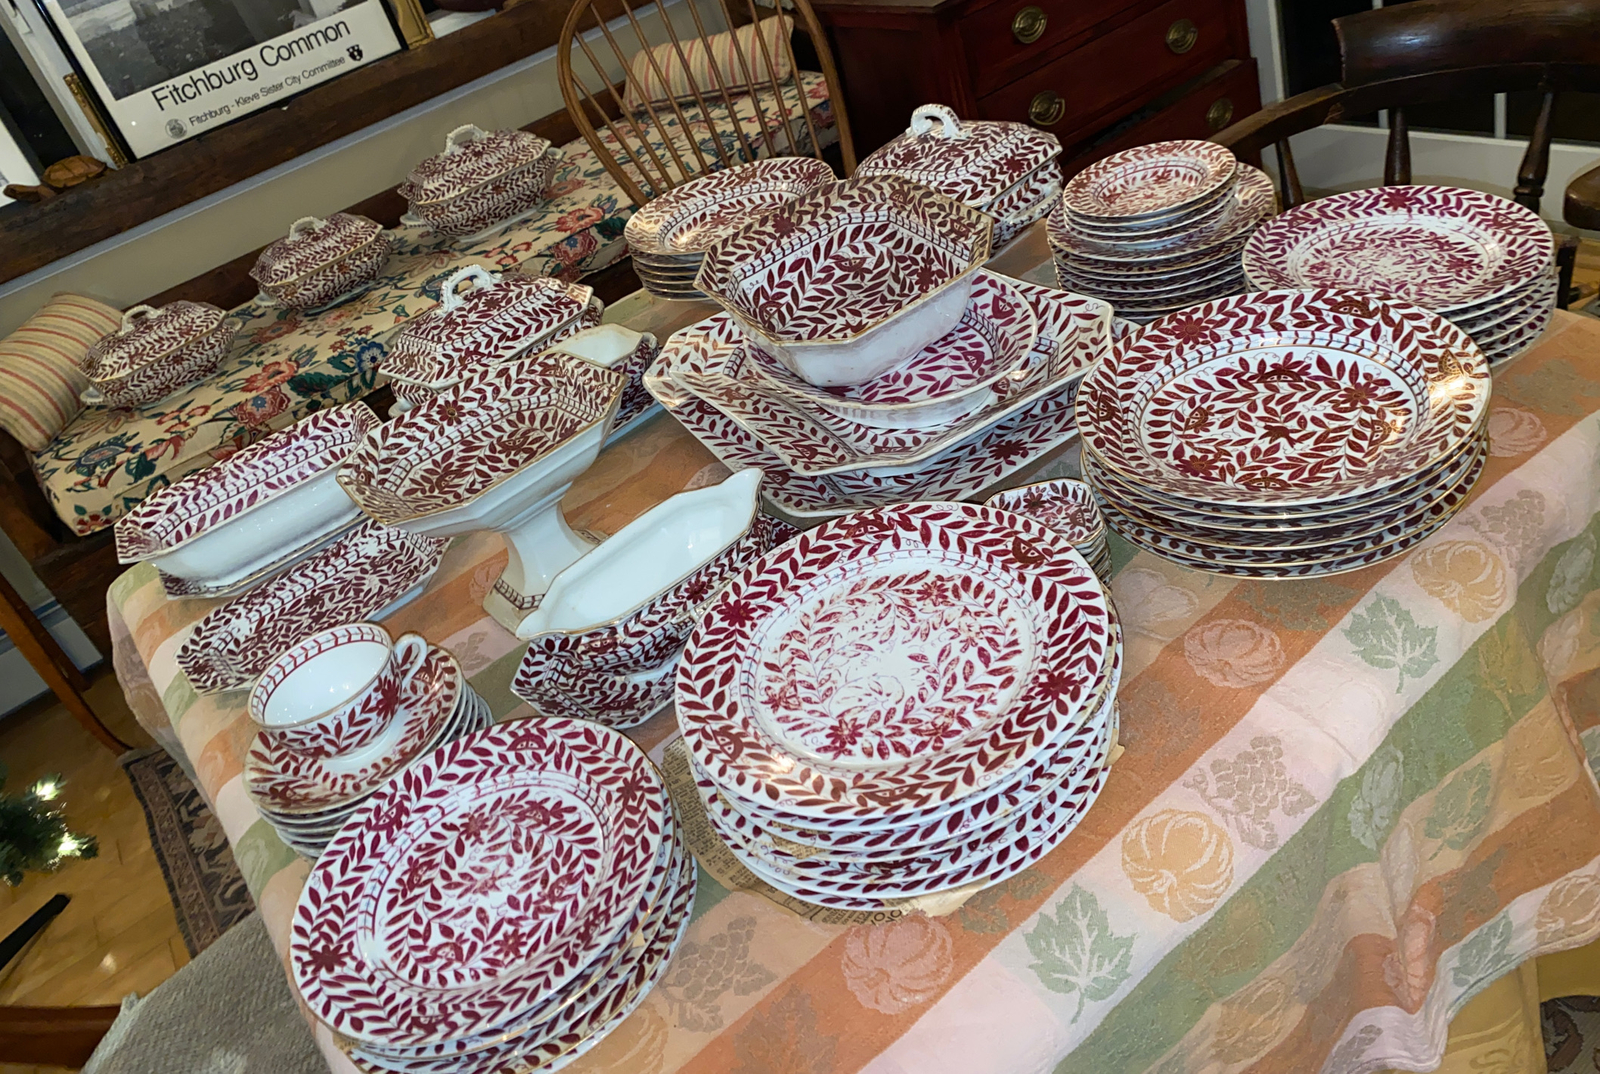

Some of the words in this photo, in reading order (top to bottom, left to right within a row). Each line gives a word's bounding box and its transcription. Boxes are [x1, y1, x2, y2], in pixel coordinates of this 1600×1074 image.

[151, 57, 259, 111] Fitchburg
[260, 20, 351, 67] Common
[188, 103, 232, 127] Fitchburg
[234, 92, 260, 108] Kleve
[259, 81, 285, 98] Sister
[284, 73, 302, 88] City
[301, 56, 346, 80] Committee
